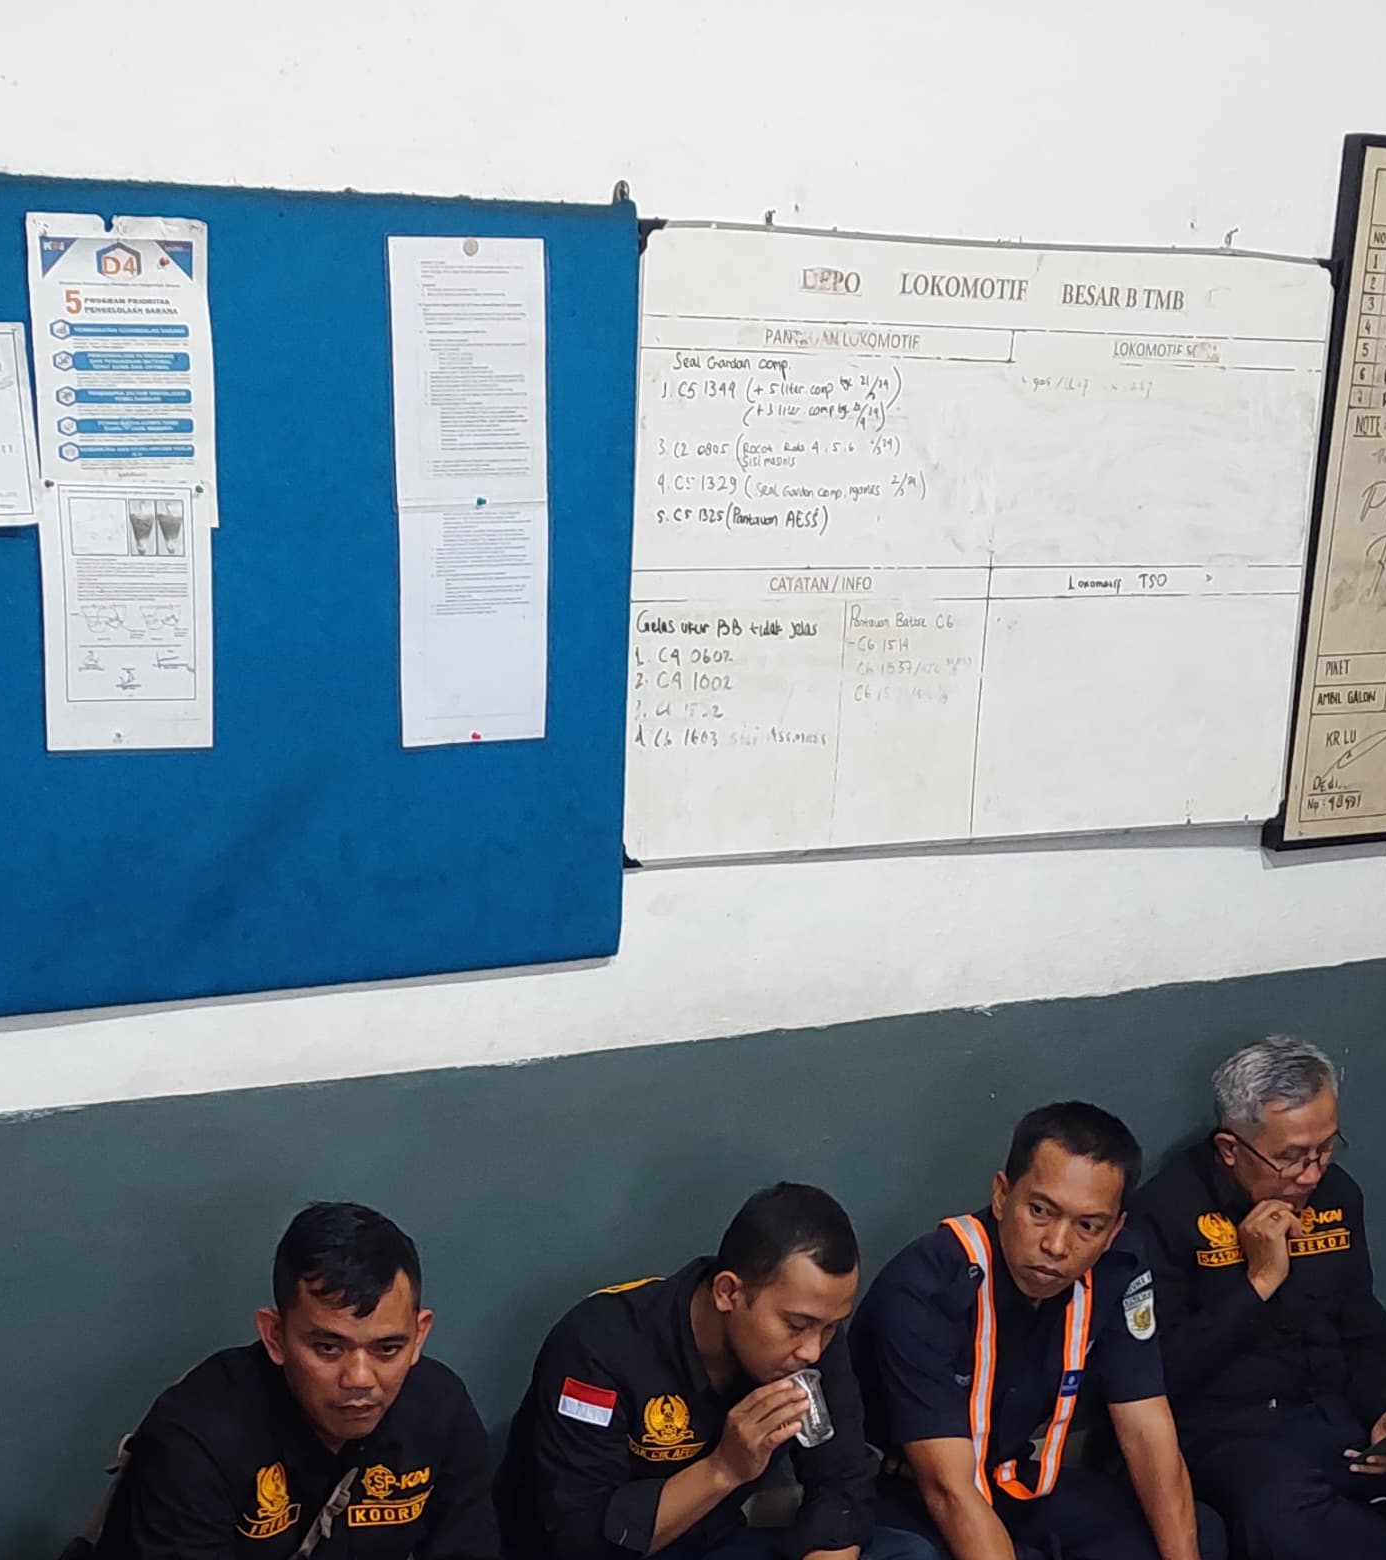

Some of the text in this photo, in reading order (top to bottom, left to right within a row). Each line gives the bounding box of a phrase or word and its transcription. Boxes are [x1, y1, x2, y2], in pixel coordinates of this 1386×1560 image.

[1373, 231, 1386, 244] NO
[103, 256, 137, 275] D4
[900, 272, 1029, 301] LOKOMOTIF
[1061, 283, 1121, 307] BESAR
[1125, 286, 1138, 308] B
[1143, 288, 1185, 311] TMB
[65, 289, 82, 315] 5
[1113, 340, 1184, 357] LOKOMOTIF
[769, 576, 829, 593] CATATAN
[841, 575, 872, 592] INFO
[1347, 690, 1376, 705] GALON
[1298, 1235, 1346, 1252] SEKDA
